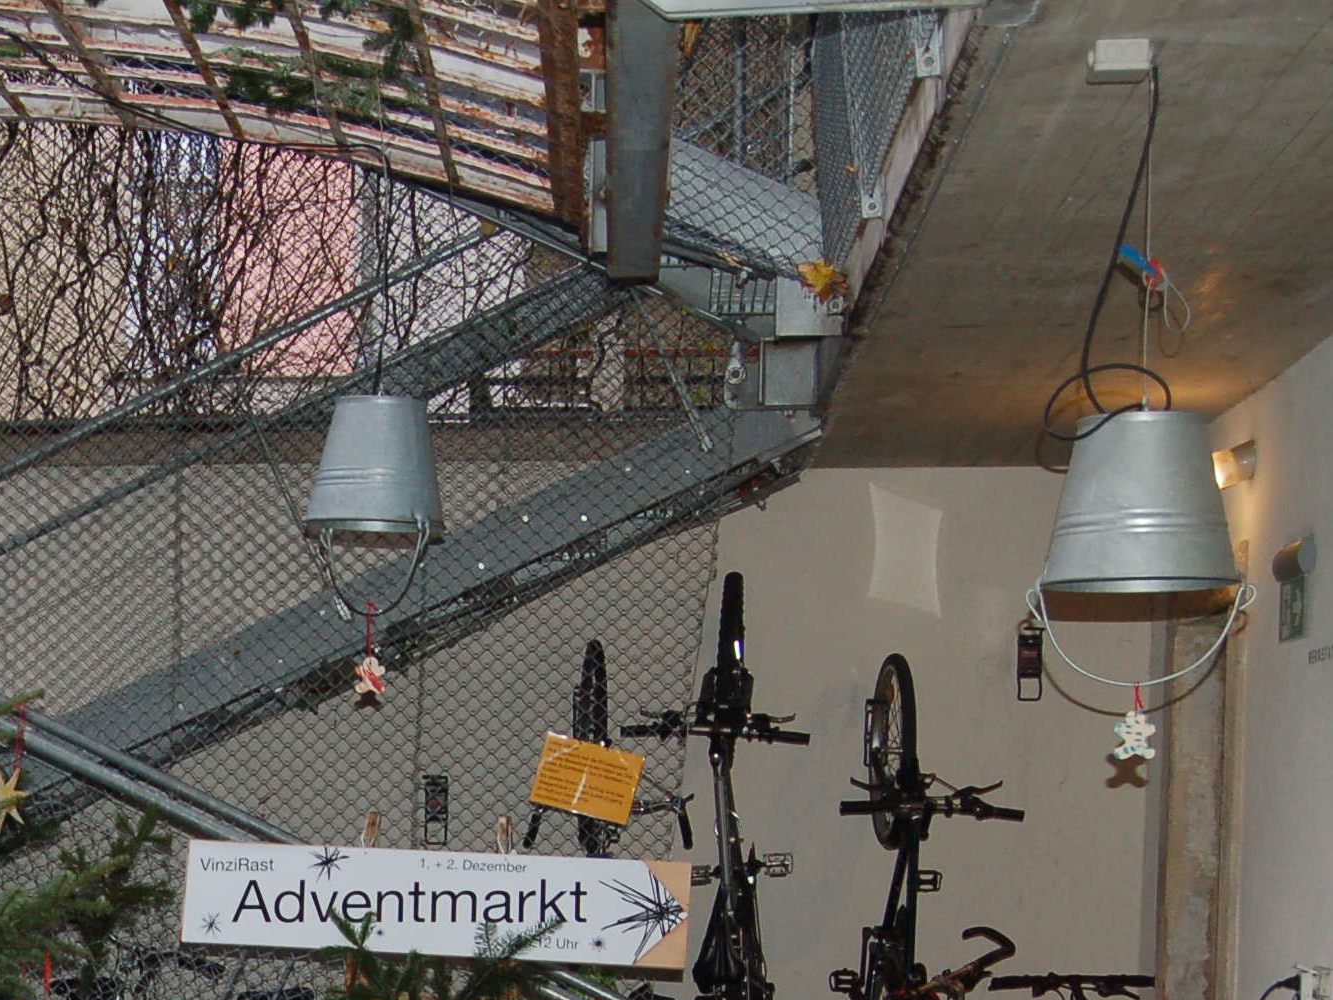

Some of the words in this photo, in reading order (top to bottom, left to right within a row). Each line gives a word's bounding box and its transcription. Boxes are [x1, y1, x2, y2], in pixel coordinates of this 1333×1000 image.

[200, 857, 274, 872] VinziRast
[420, 858, 430, 869] 1.
[446, 859, 458, 870] 2.
[462, 859, 528, 873] Dezember
[232, 879, 588, 924] Adventmarkt
[556, 937, 579, 950] Uhr
